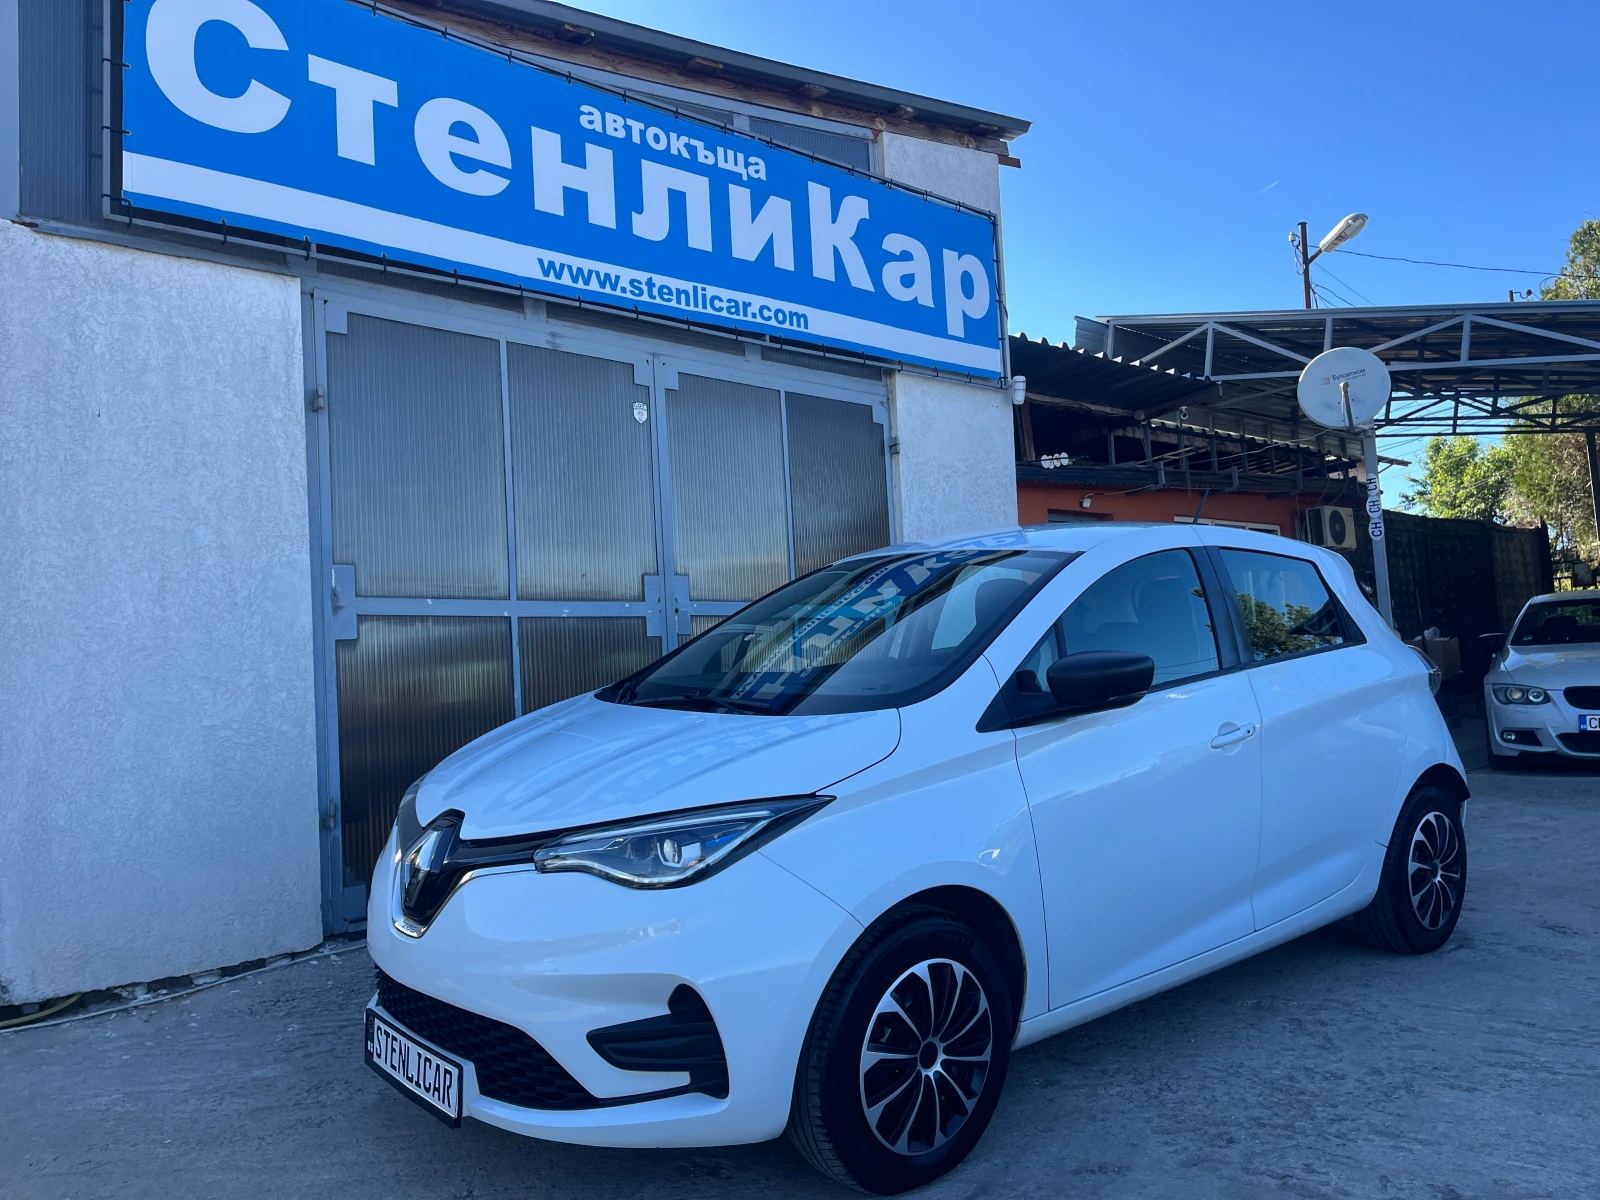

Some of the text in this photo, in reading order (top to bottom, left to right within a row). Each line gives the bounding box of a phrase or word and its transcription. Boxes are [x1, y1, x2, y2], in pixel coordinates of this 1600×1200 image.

[145, 0, 990, 338] СтенлиКар
[579, 104, 767, 181] автокъща
[537, 257, 809, 330] www.stenlicar.com
[1371, 521, 1382, 537] CH
[1589, 717, 1600, 729] C
[375, 1025, 453, 1109] STENLICAR
